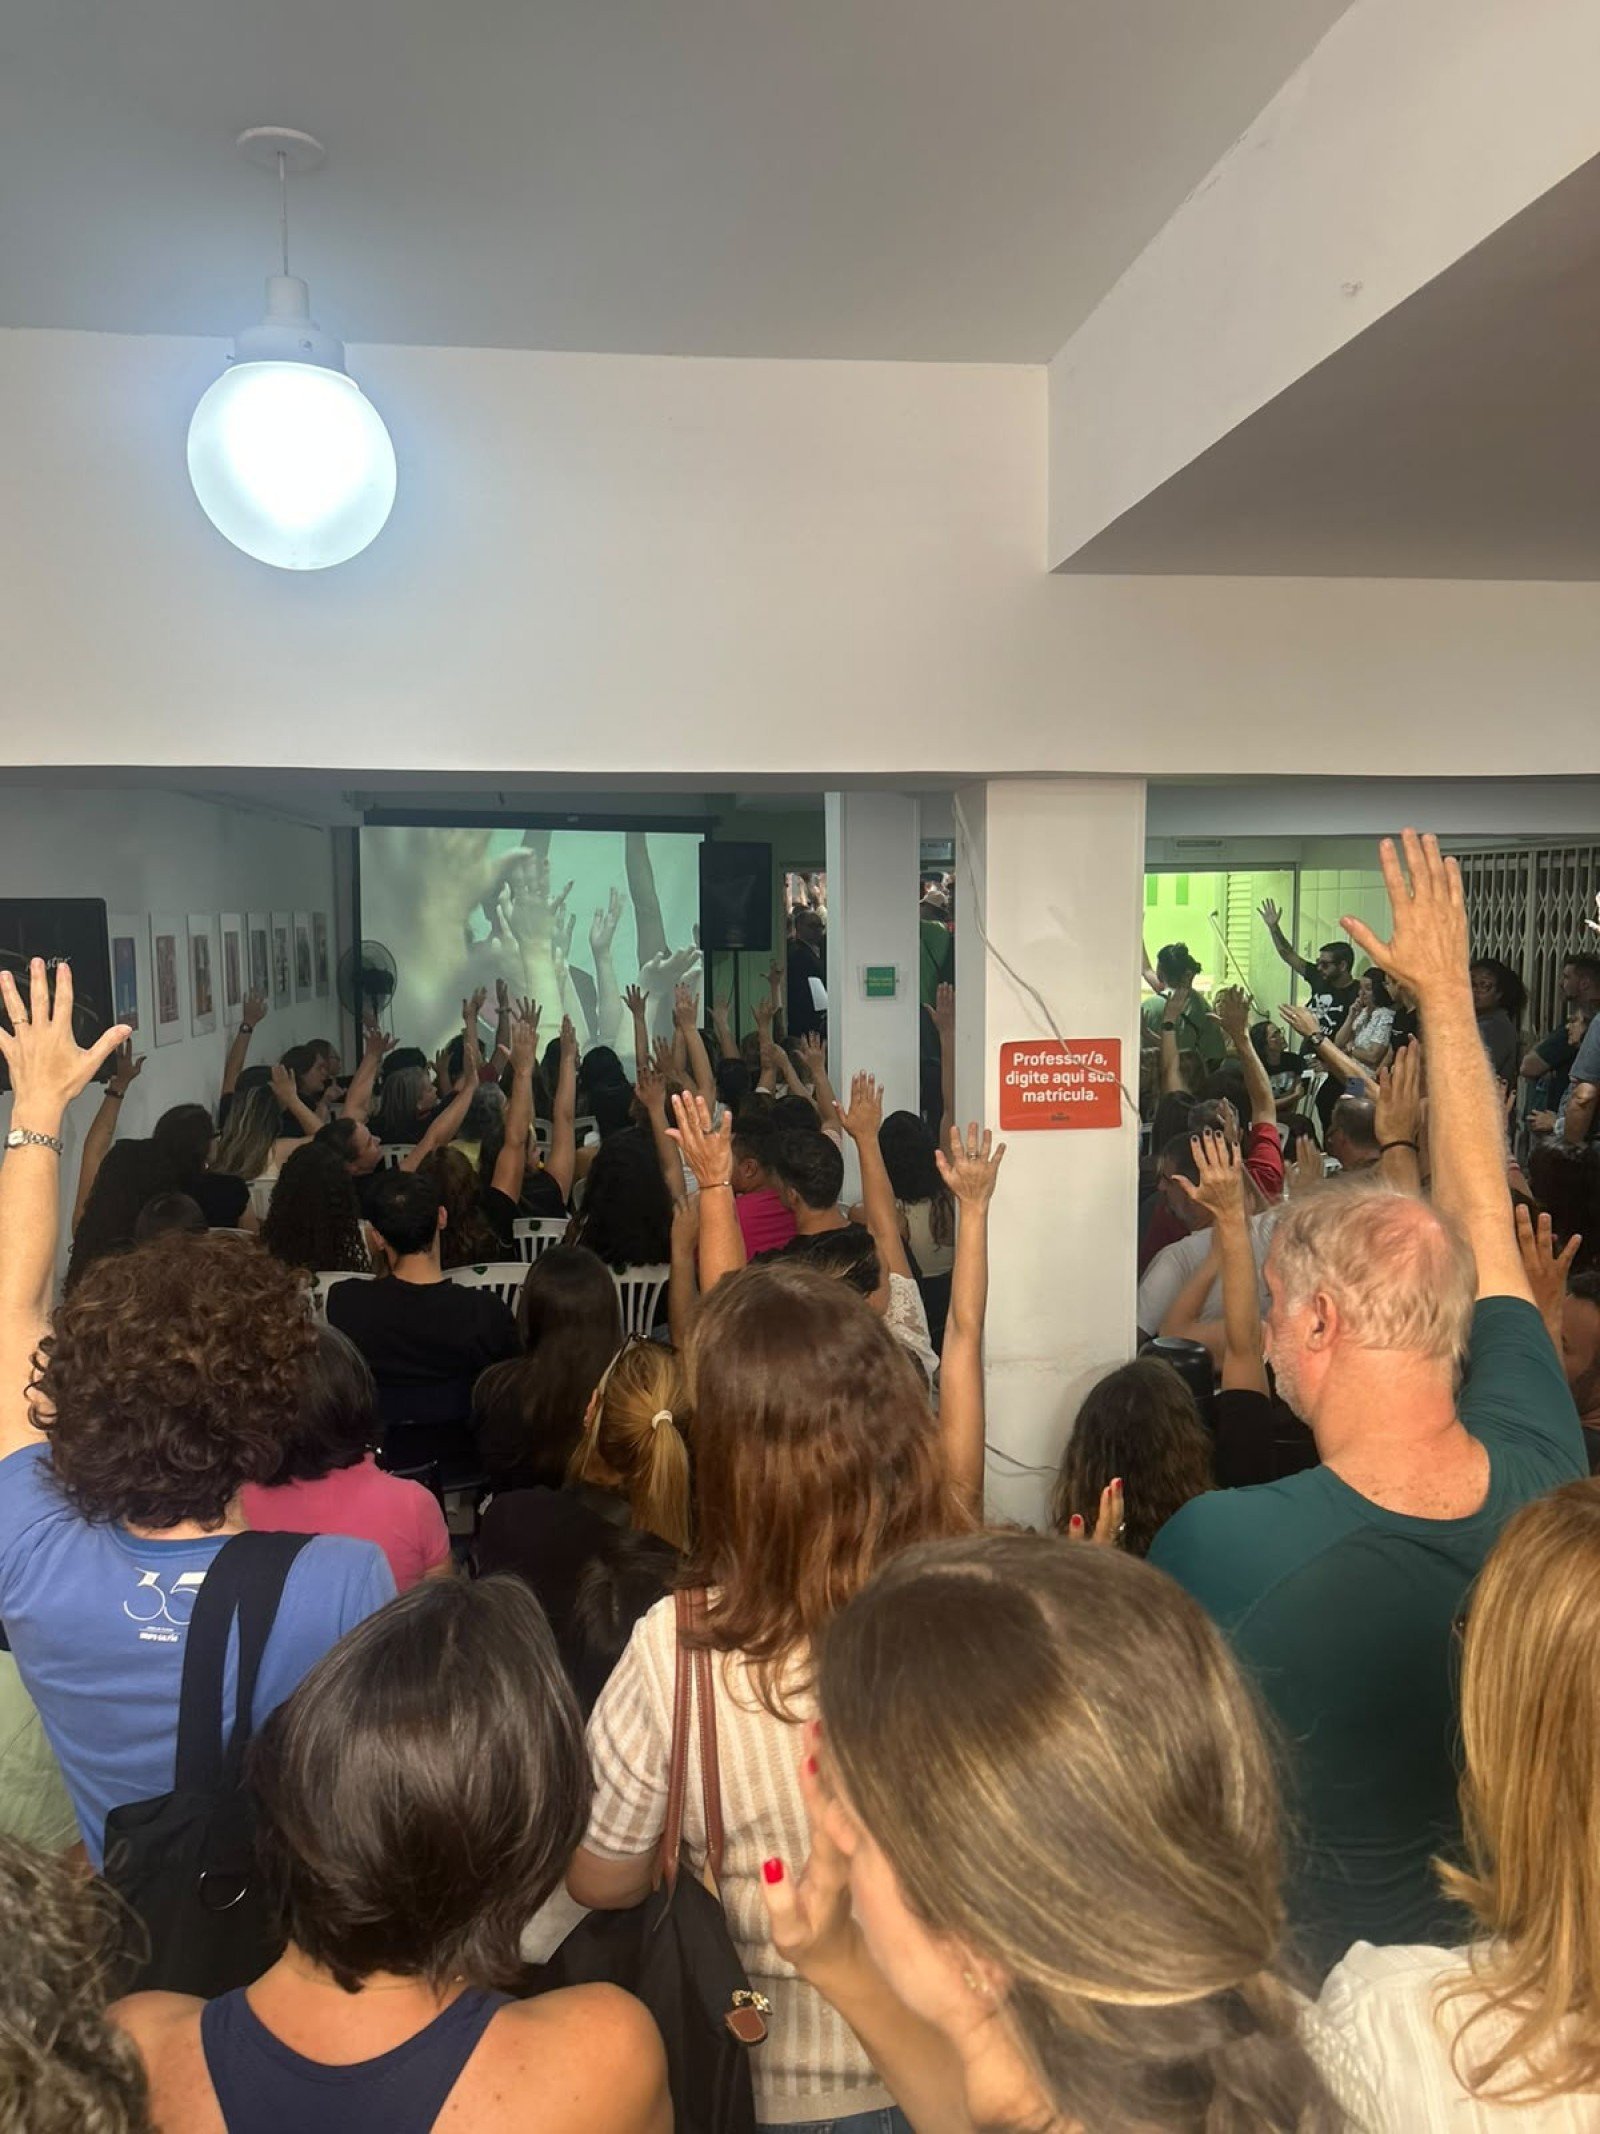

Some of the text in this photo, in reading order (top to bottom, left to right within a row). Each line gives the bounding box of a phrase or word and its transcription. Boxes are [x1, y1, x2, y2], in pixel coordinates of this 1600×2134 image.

[1013, 1051, 1107, 1066] Professor/a,
[1006, 1070, 1115, 1087] digite aqui sua
[1022, 1087, 1098, 1103] matrícula.
